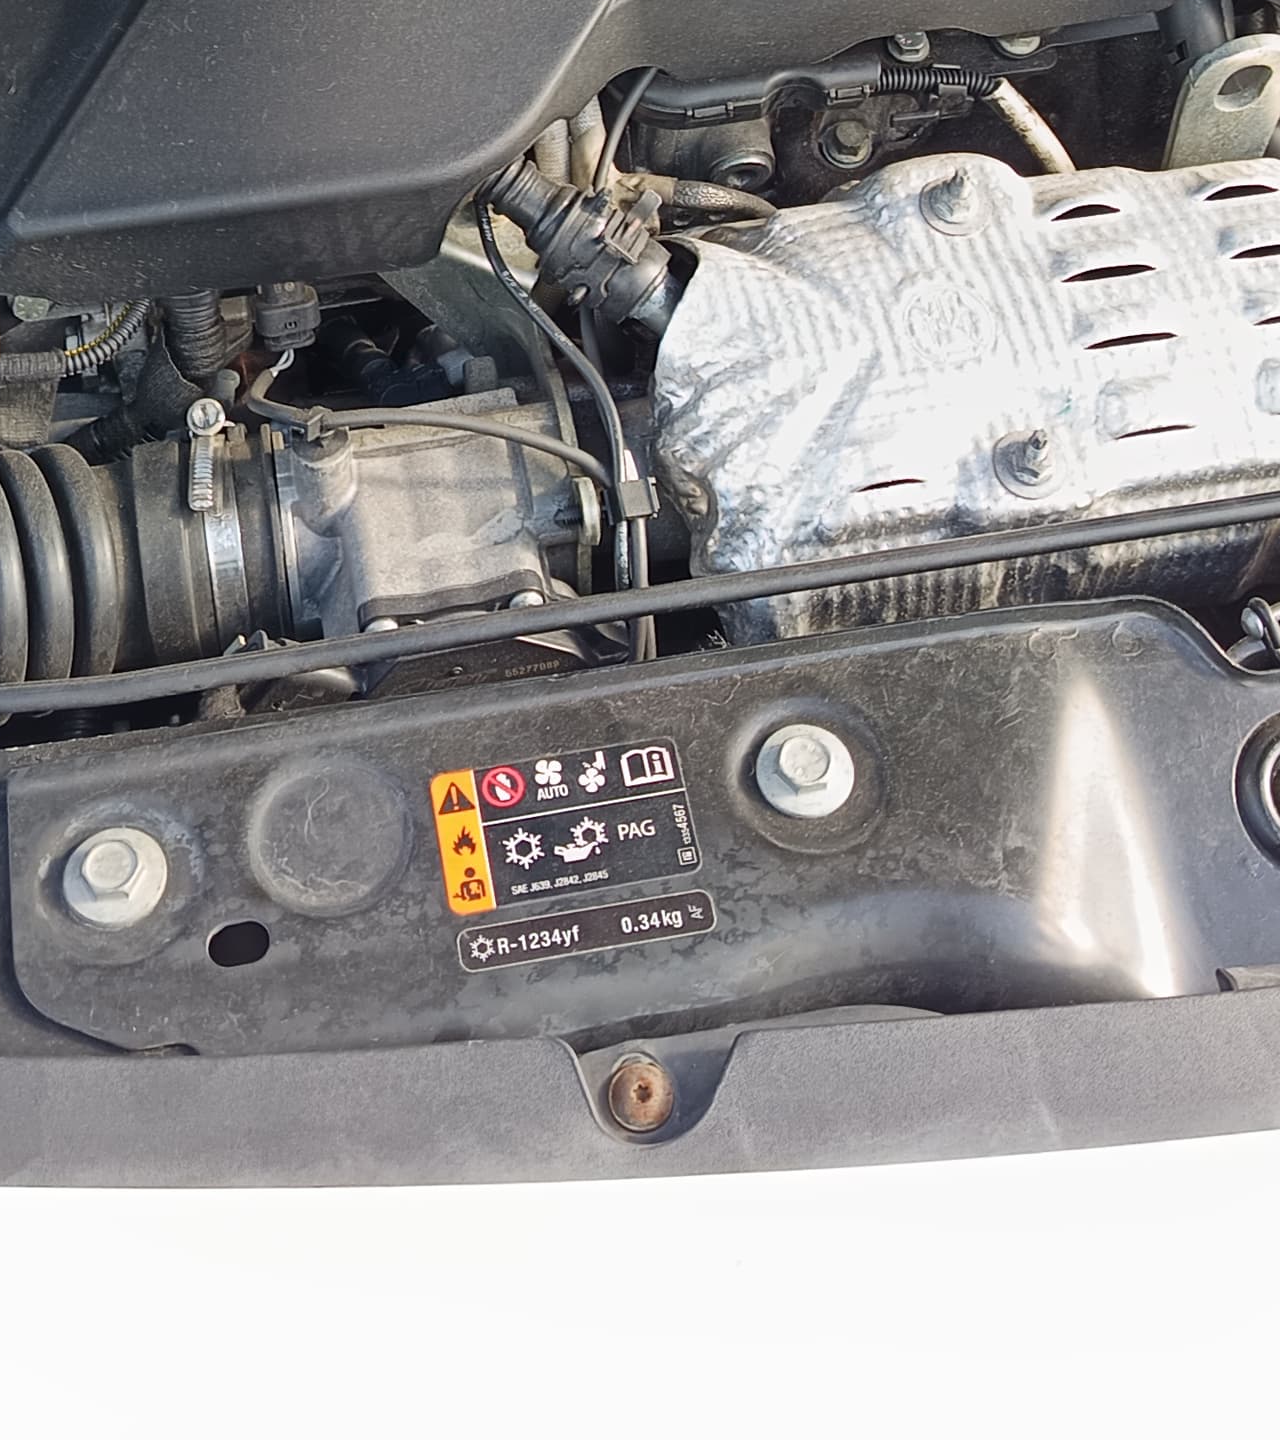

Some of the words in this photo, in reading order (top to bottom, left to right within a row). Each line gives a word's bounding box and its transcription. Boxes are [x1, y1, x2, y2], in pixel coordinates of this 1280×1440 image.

[537, 784, 569, 801] AUTO
[618, 819, 656, 841] PAG
[688, 904, 705, 920] AF
[497, 925, 581, 956] R-1234yf
